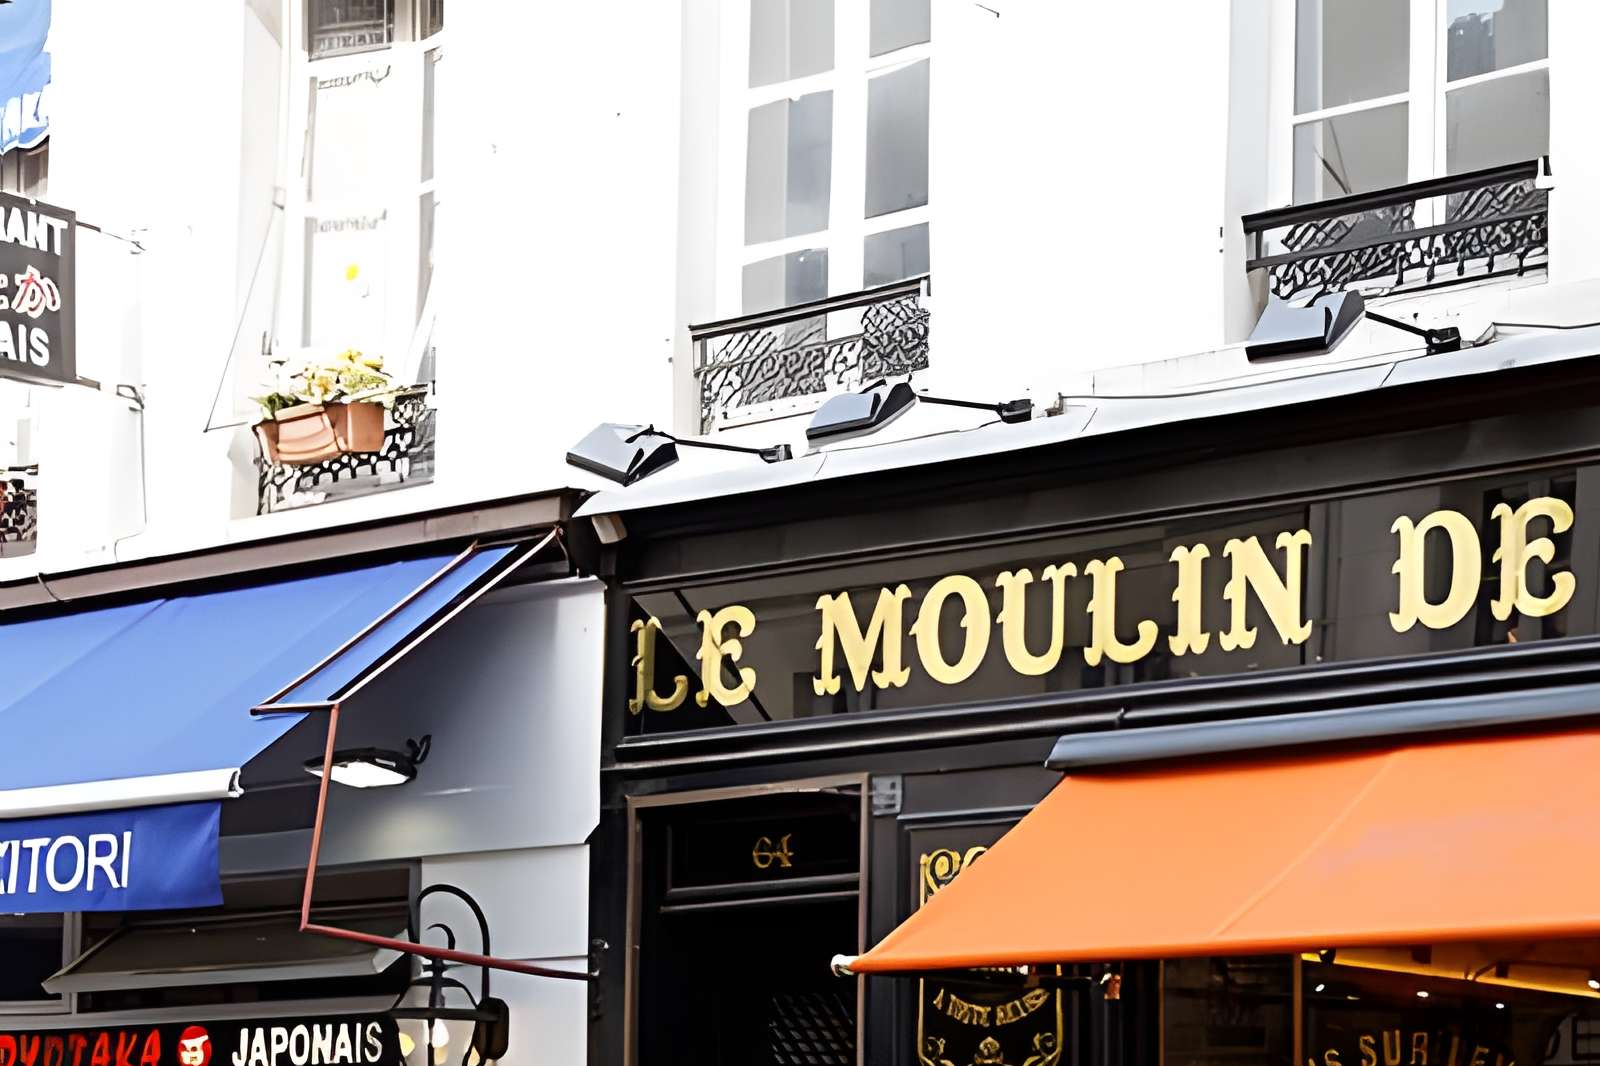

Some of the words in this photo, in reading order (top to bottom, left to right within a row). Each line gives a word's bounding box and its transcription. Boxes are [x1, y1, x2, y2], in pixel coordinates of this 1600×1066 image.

[0, 205, 68, 256] ANT
[628, 606, 757, 715] LE
[812, 529, 1313, 697] MOULIN
[1389, 496, 1576, 633] DE
[752, 833, 795, 869] 64
